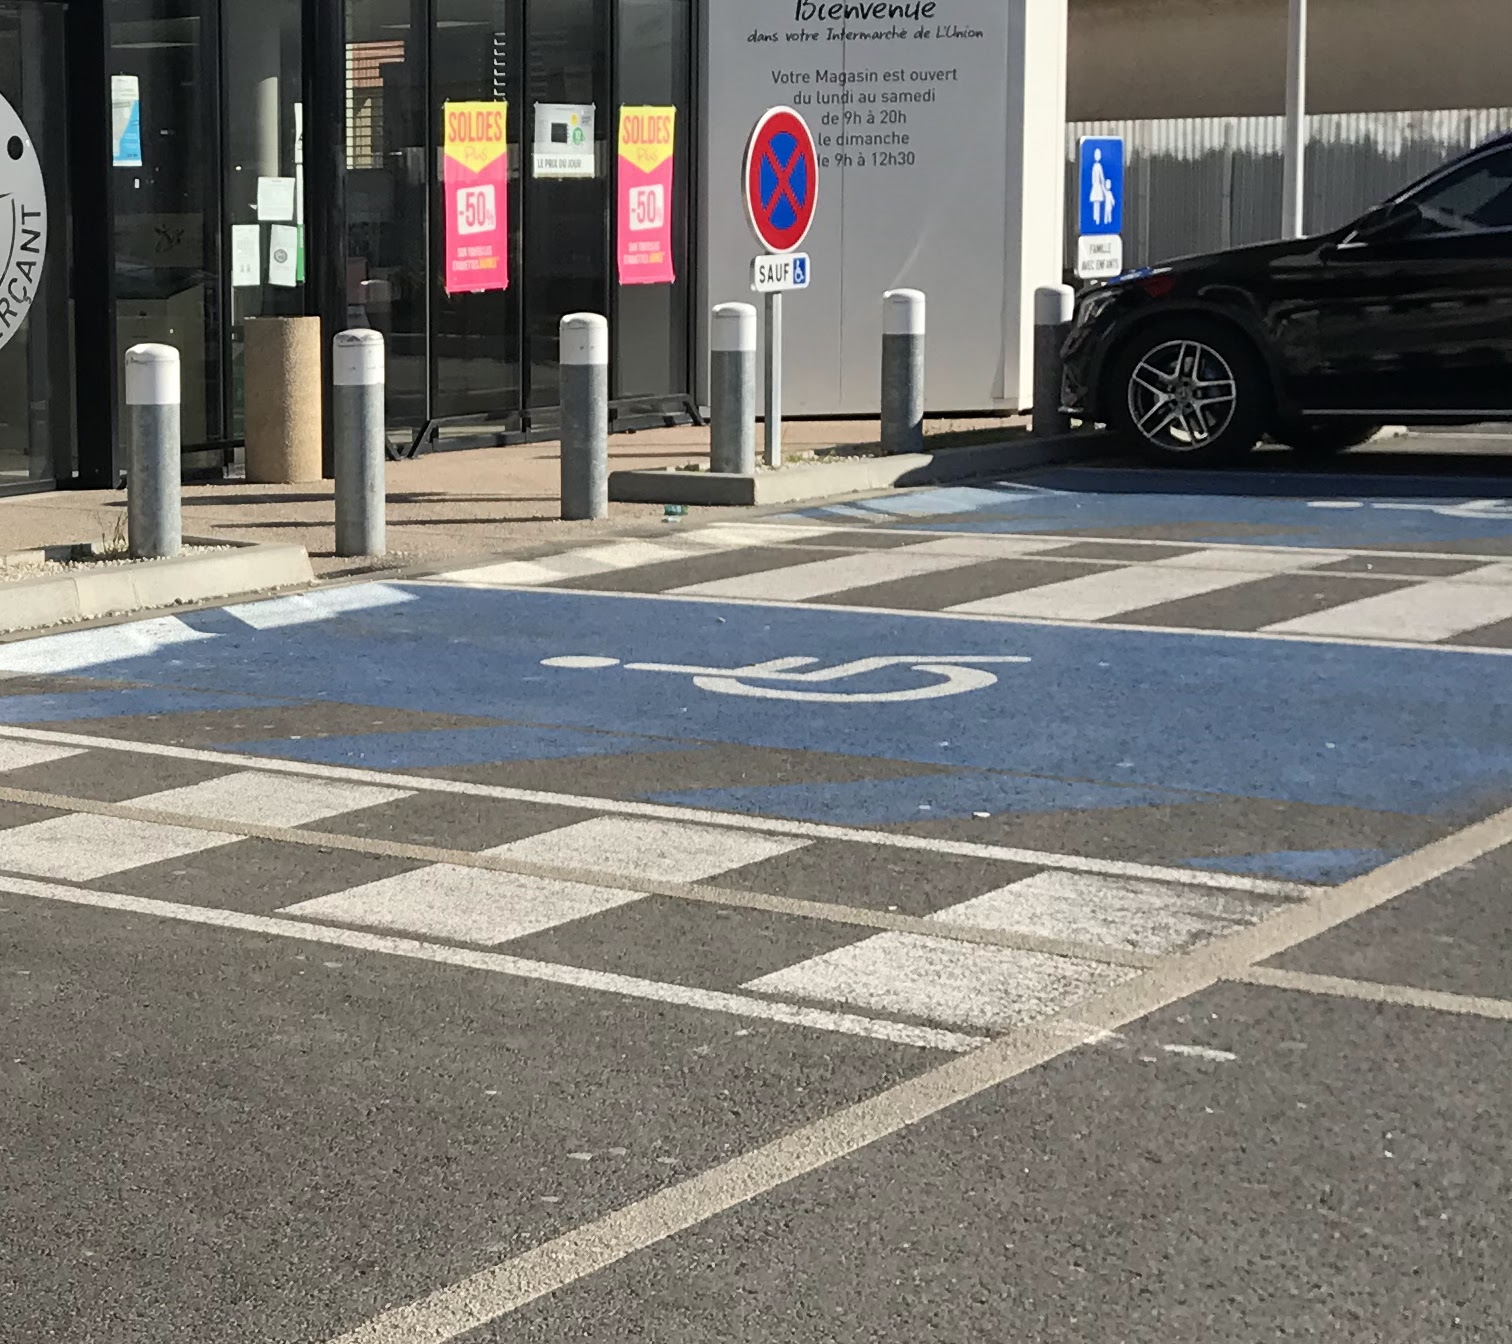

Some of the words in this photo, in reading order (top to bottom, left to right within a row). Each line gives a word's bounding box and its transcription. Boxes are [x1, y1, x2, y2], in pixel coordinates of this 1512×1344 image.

[747, 29, 779, 43] dans
[786, 28, 820, 42] votre
[913, 25, 931, 39] de
[935, 24, 985, 39] L'Union
[771, 70, 811, 84] Votre
[815, 68, 879, 86] Magasin
[882, 69, 905, 82] est
[909, 68, 958, 82] ouvert
[793, 91, 812, 105] du
[816, 90, 854, 105] lundi
[857, 92, 877, 104] au
[881, 88, 936, 103] samedi
[821, 112, 839, 126] de
[843, 111, 862, 125] 9h
[866, 109, 876, 124] à
[879, 110, 907, 124] 20h
[448, 111, 503, 143] SOLDES
[622, 115, 671, 145] SOLDES
[817, 132, 832, 146] le
[836, 131, 910, 146] dimanche
[834, 153, 853, 167] 9h
[857, 151, 866, 167] à
[871, 151, 916, 167] 12h30
[758, 263, 790, 284] SAUF
